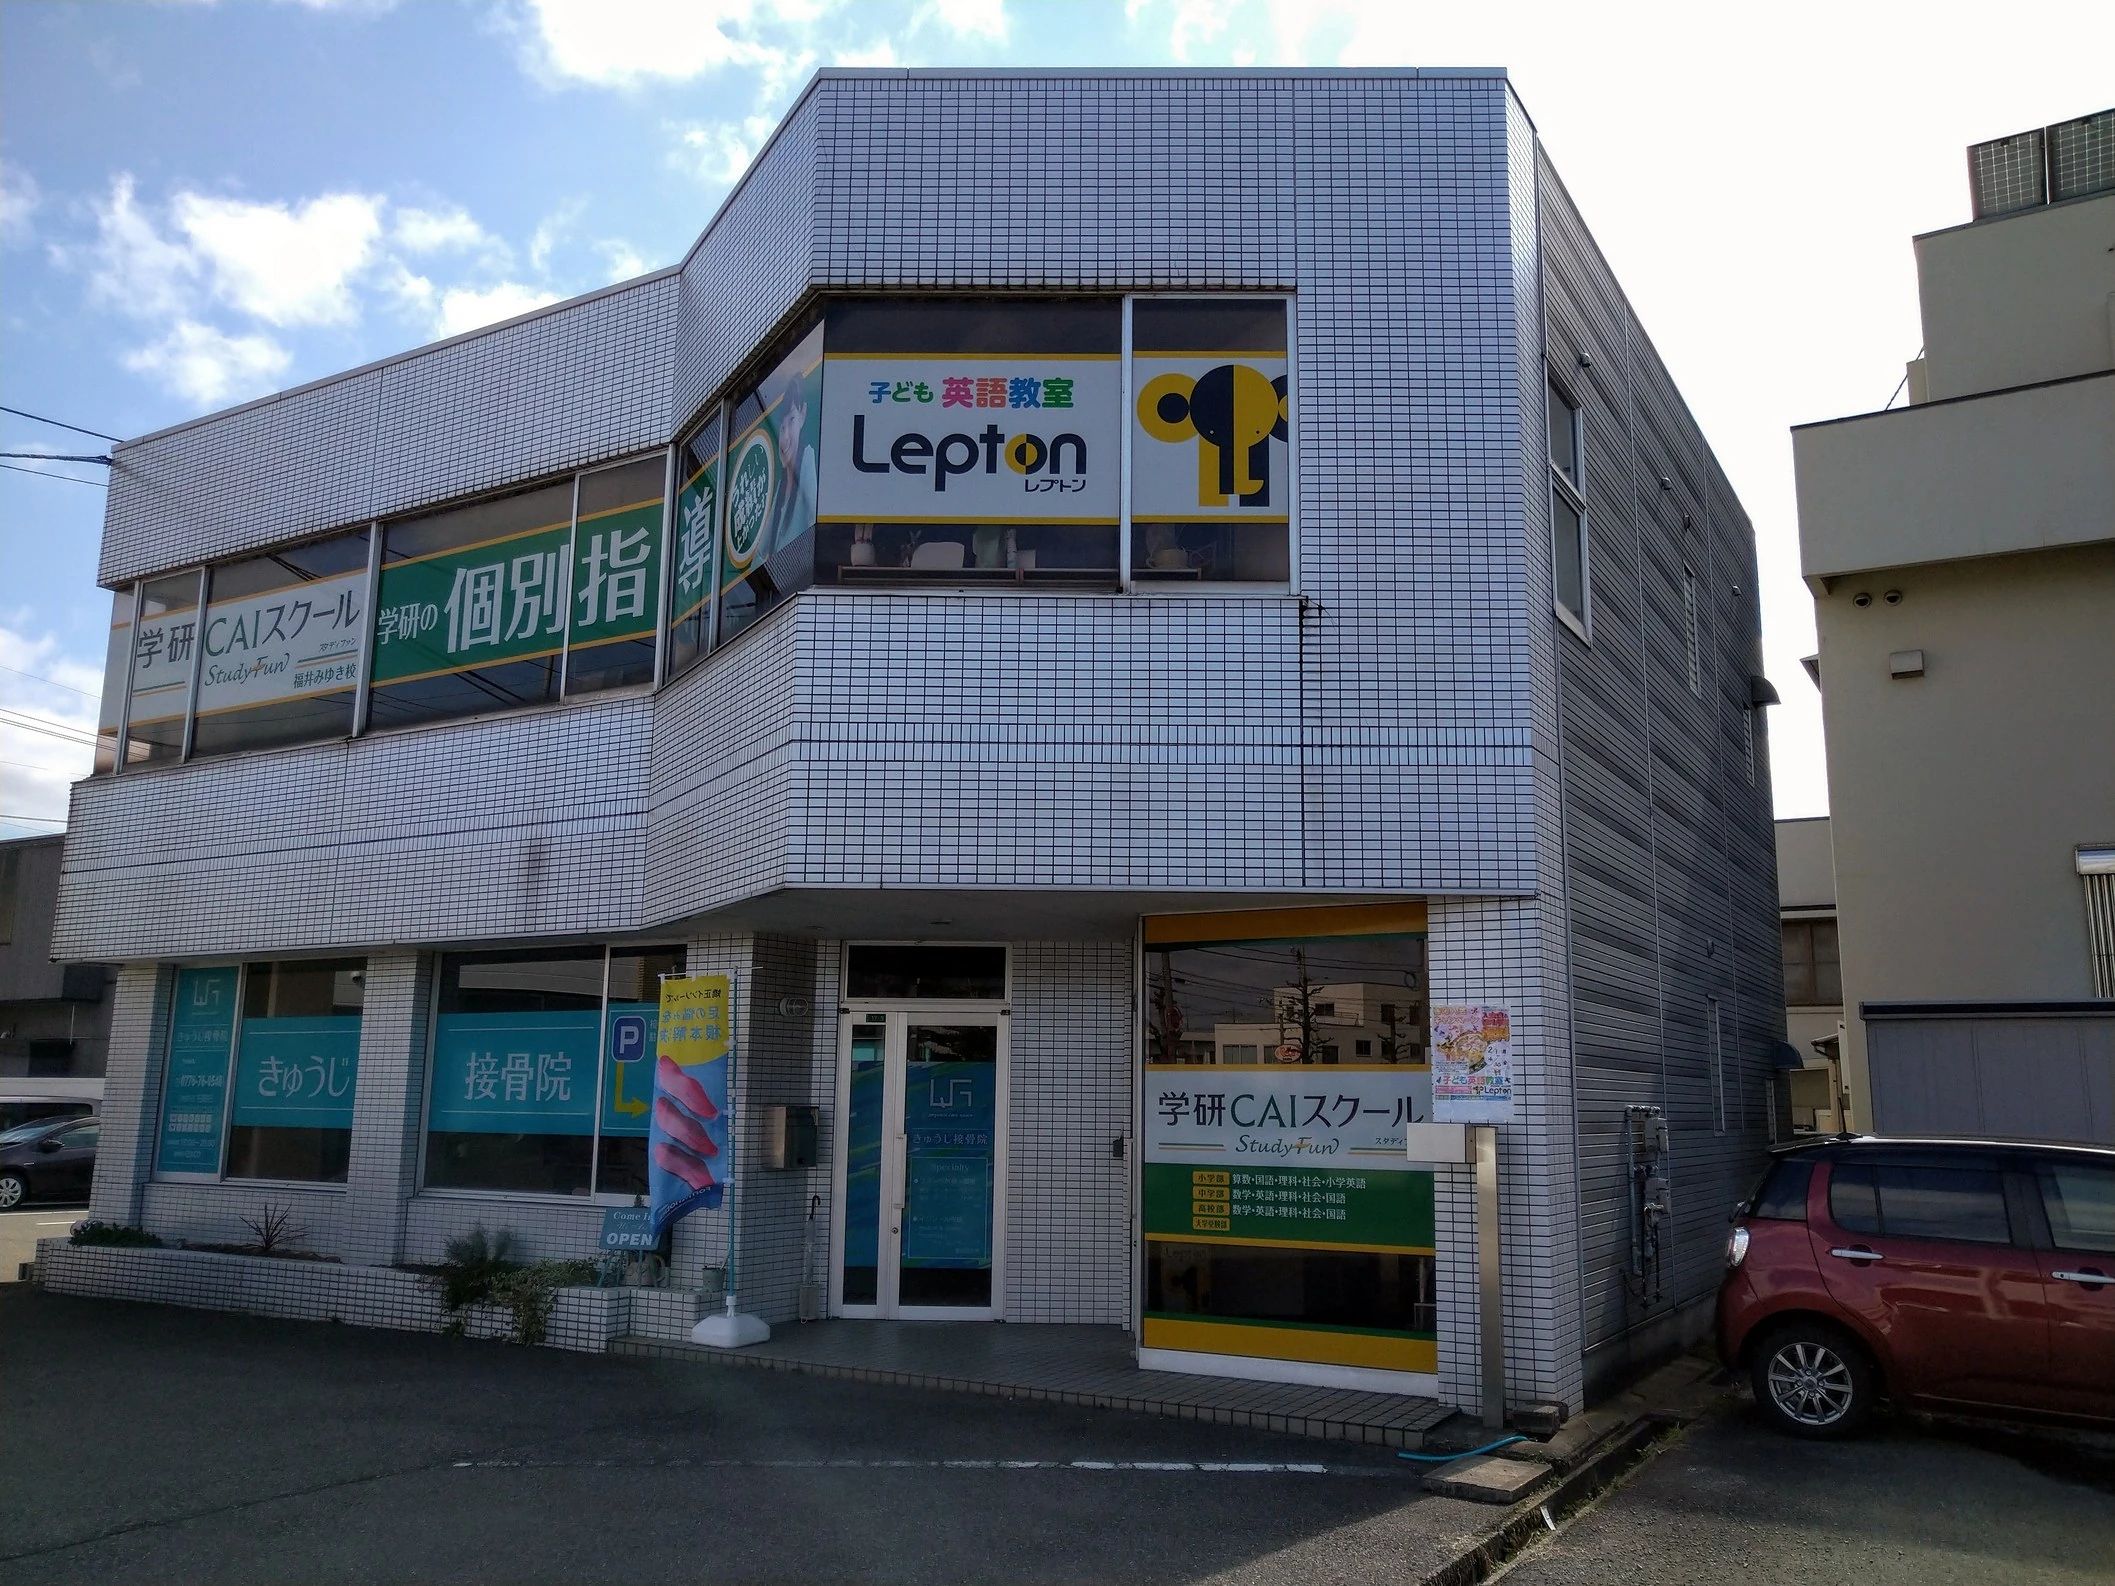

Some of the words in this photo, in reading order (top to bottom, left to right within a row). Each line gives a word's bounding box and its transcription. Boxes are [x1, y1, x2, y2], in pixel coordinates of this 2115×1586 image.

[869, 382, 934, 404] 子ども
[942, 377, 1074, 409] 英語教室
[853, 415, 1086, 491] Lepton
[1025, 478, 1086, 493] レプトン
[293, 663, 357, 689] 福井みゆき校
[620, 1026, 640, 1054] P
[257, 1055, 349, 1098] きゅうじ
[465, 1051, 571, 1102] 接骨院
[1484, 1086, 1511, 1095] Lepton
[1158, 1093, 1424, 1127] 学研CAIスクール
[1375, 1137, 1408, 1146] スタディ
[1198, 1174, 1225, 1183] 小学部
[1198, 1189, 1225, 1199] 中学部
[607, 1233, 653, 1246] OPEN
